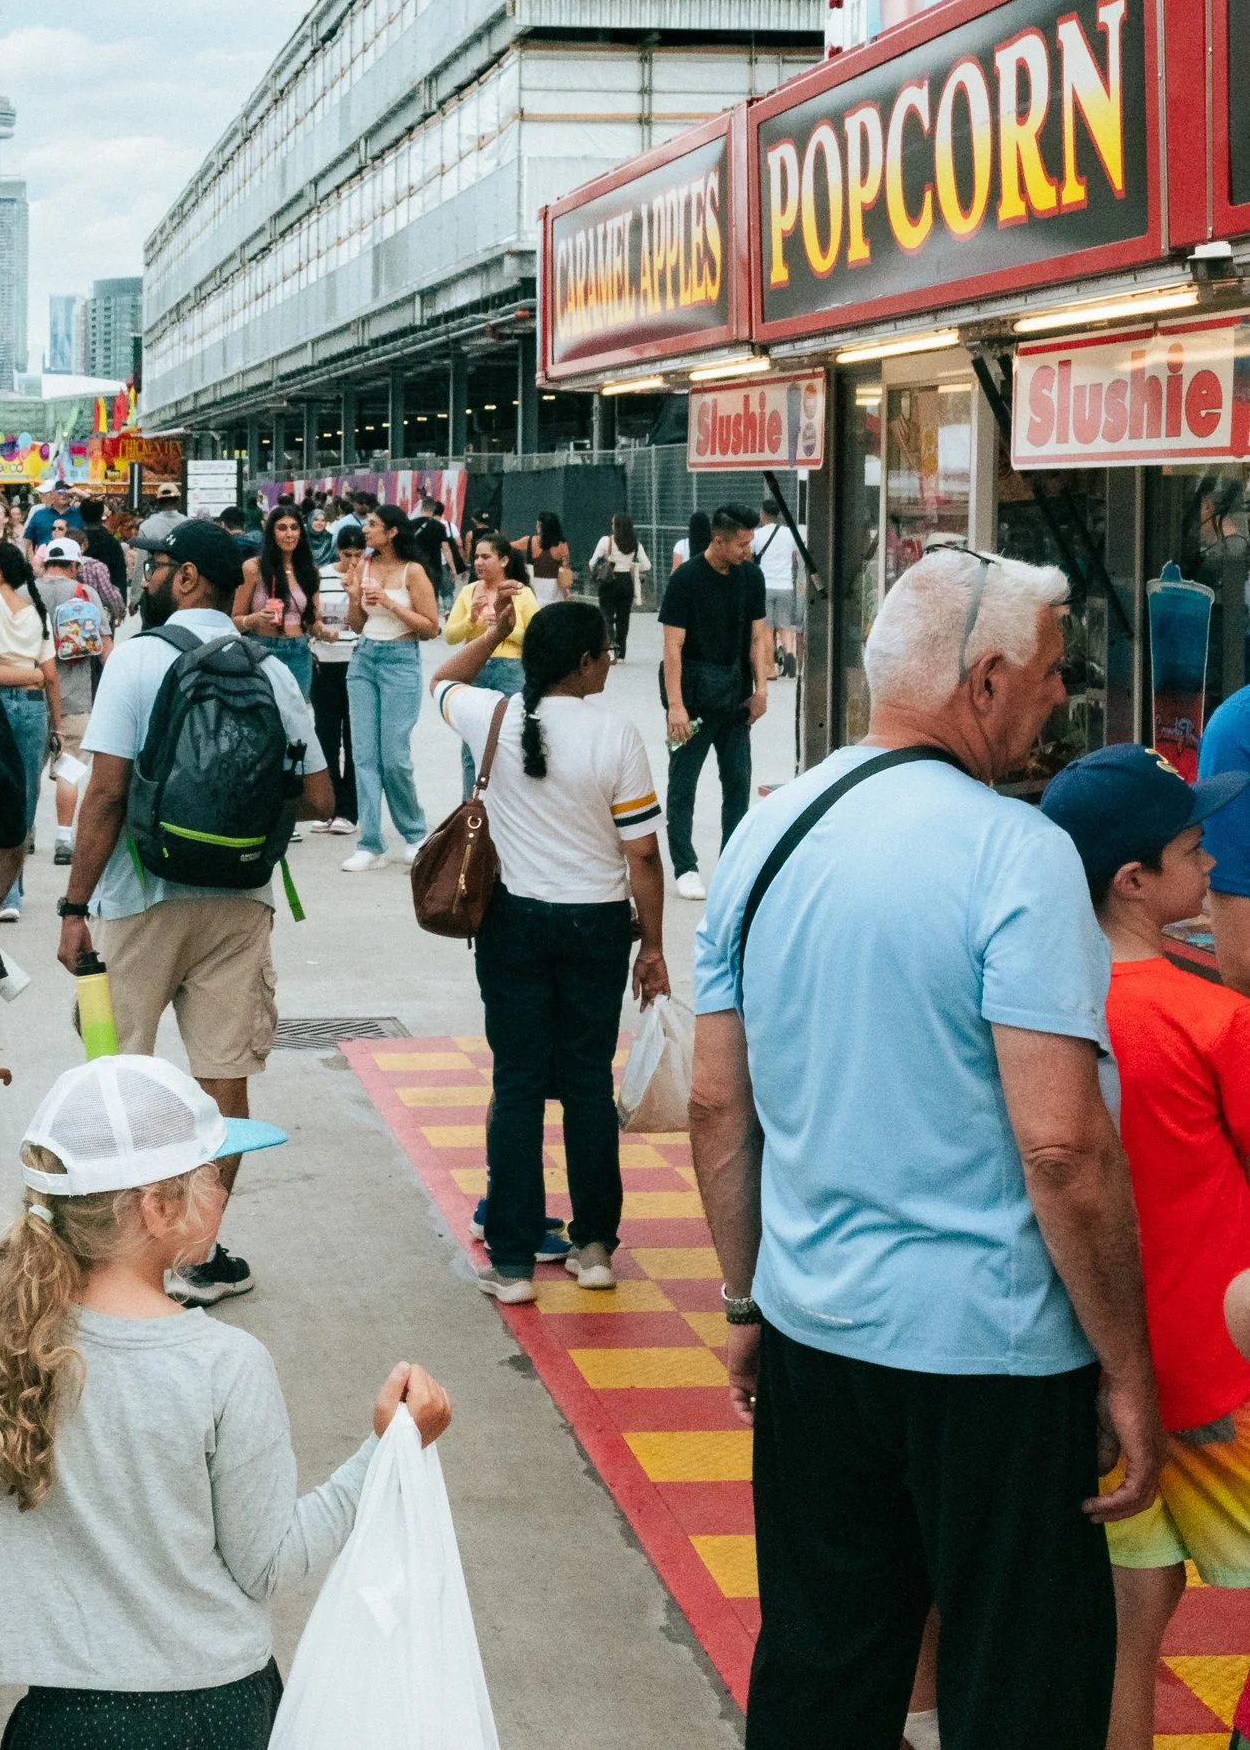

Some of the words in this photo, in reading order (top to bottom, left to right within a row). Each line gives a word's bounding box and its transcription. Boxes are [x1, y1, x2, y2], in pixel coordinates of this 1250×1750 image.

[557, 208, 636, 340] CARAMEL
[639, 169, 722, 313] APPLES
[695, 390, 782, 458] Slushie
[1025, 342, 1224, 448] Slushie
